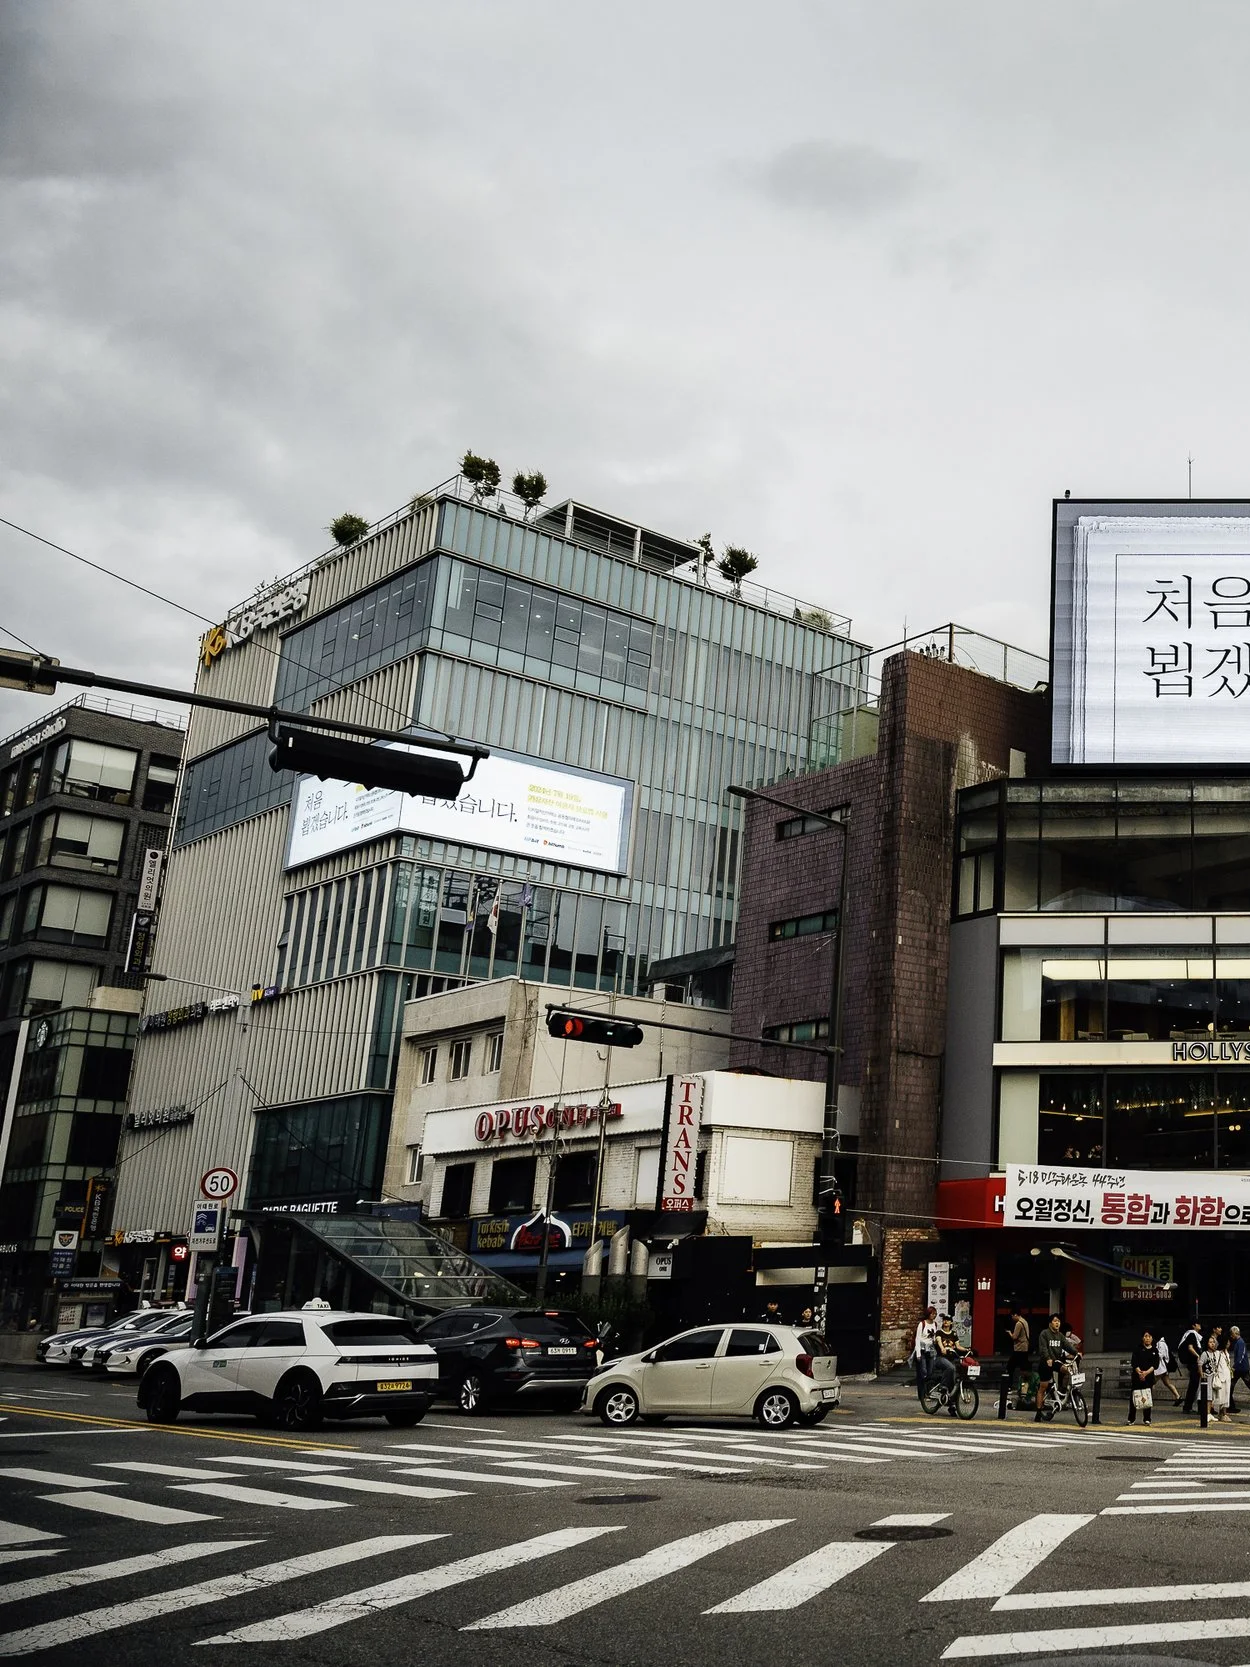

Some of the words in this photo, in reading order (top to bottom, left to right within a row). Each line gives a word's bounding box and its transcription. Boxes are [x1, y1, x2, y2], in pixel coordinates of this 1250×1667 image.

[304, 790, 322, 812] 처음
[301, 802, 348, 837] 뵙겠습니다.
[475, 1105, 544, 1142] OPUS
[672, 1082, 696, 1195] TRANS
[210, 1176, 230, 1192] 50
[1092, 1173, 1126, 1188] 44주년
[665, 1198, 690, 1209] 오퍼스
[1014, 1197, 1094, 1224] 오월정신,
[1100, 1192, 1170, 1225] 통합과
[174, 1246, 187, 1258] 약
[656, 1256, 672, 1266] OPUS
